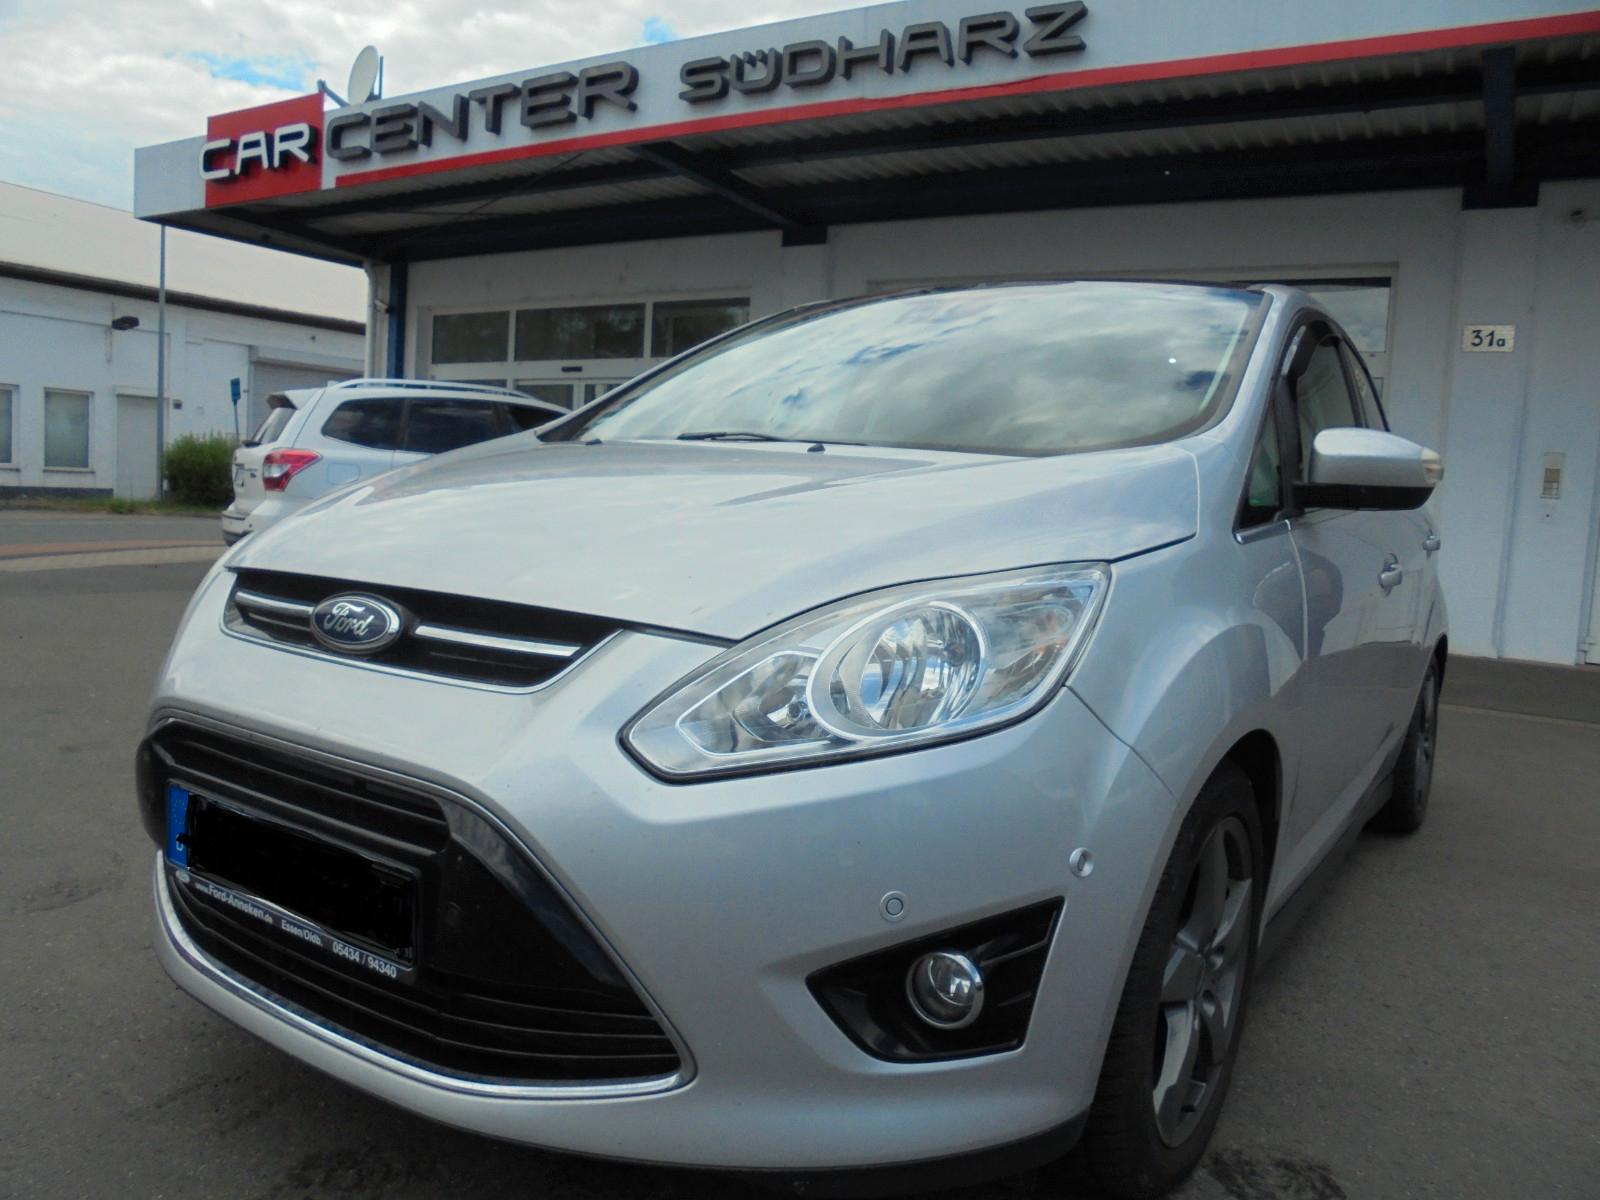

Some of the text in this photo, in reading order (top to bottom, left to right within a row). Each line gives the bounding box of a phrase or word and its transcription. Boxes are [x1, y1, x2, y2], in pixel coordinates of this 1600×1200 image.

[200, 0, 1089, 181] CAR CENTER SÜDHARZ
[1471, 329, 1506, 347] 31a
[323, 602, 375, 636] Ford
[332, 941, 360, 963] 05434
[367, 956, 397, 978] 94340
